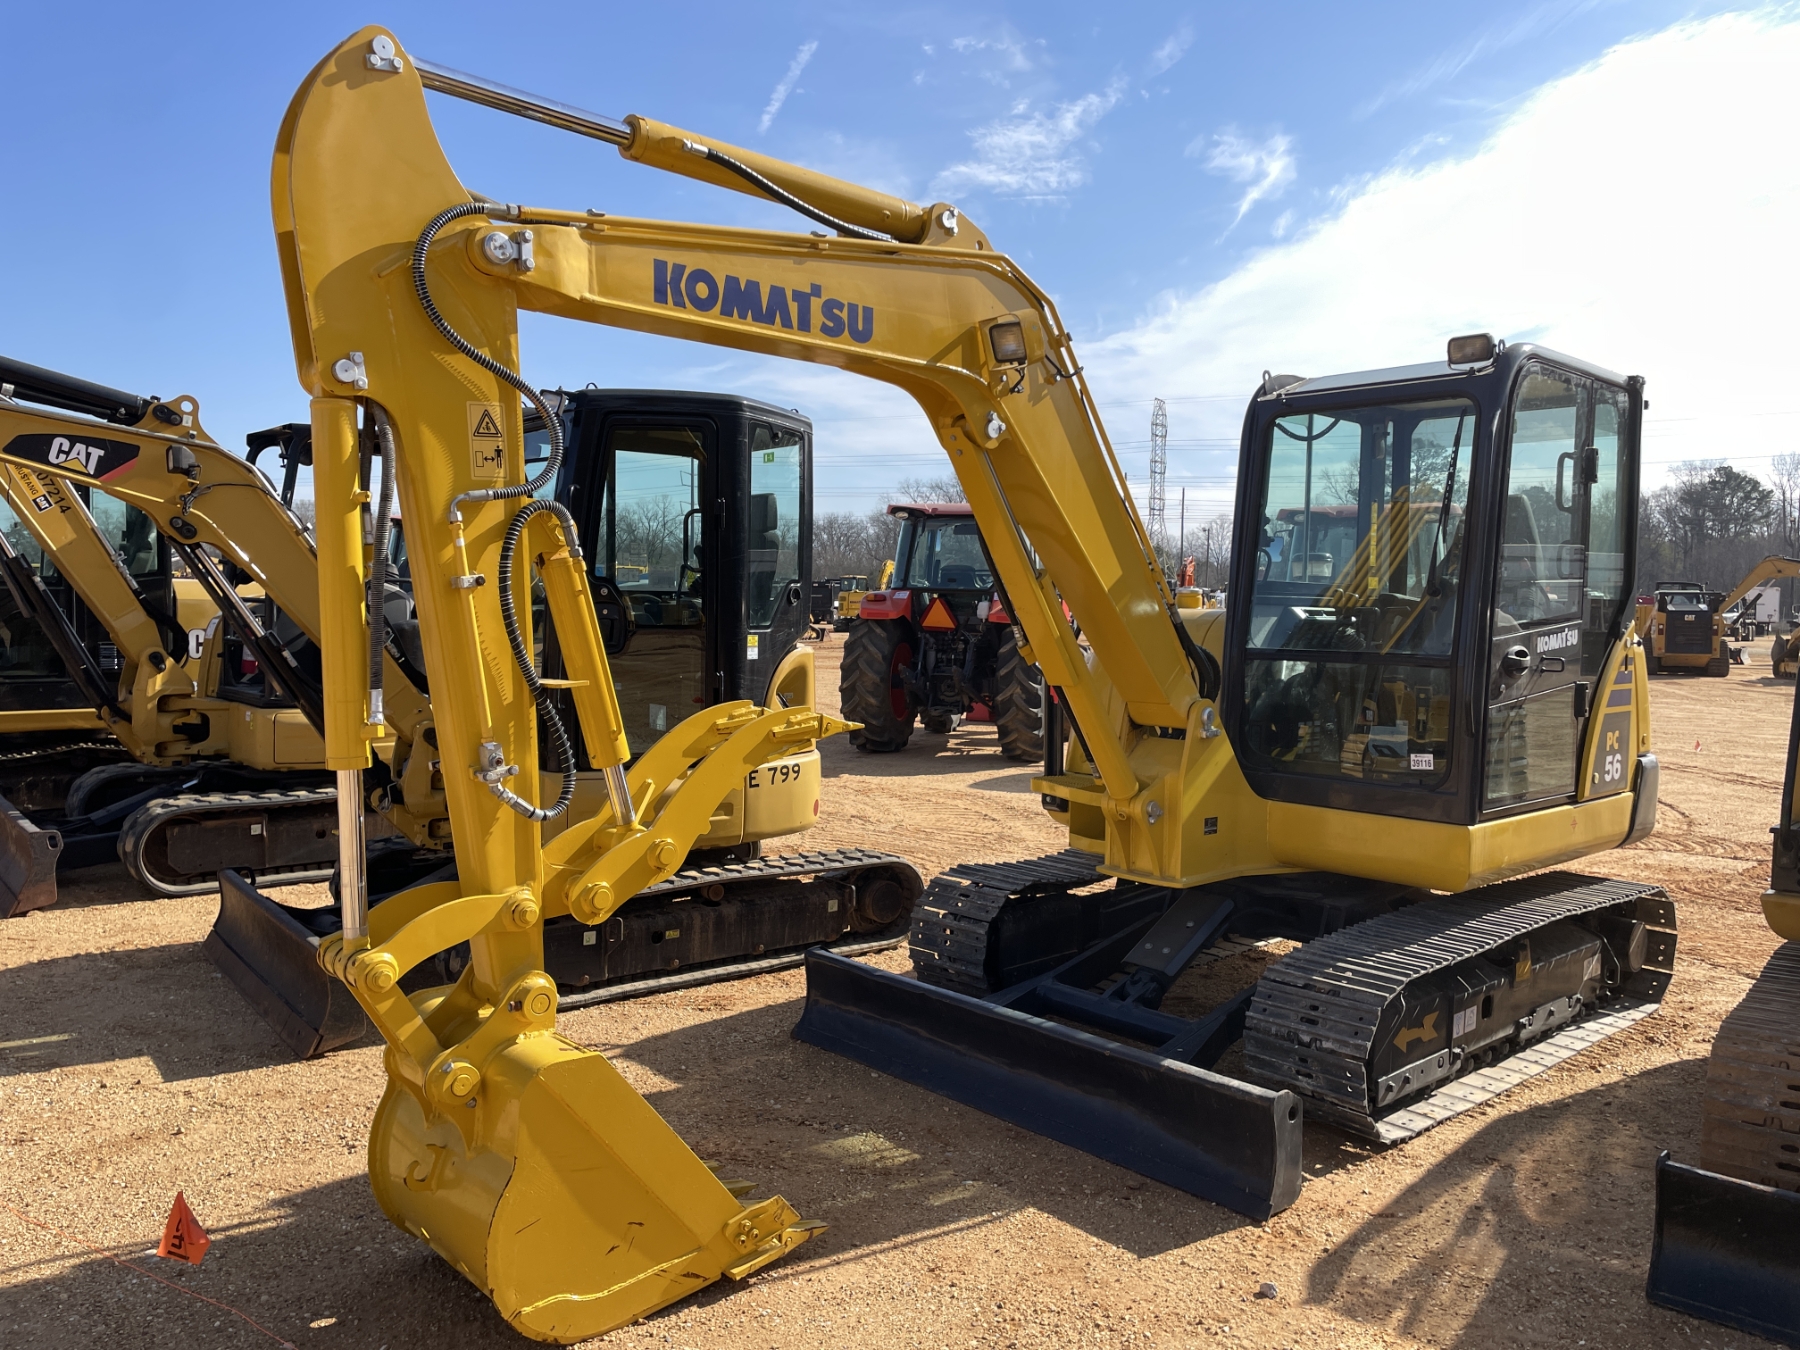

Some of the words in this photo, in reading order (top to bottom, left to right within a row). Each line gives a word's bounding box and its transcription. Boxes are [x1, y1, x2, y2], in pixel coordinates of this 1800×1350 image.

[653, 258, 874, 344] KOMATSU
[48, 437, 105, 475] CAT
[35, 495, 50, 510] CAT
[1537, 627, 1579, 654] KOMATSU
[1606, 730, 1620, 751] PC
[748, 769, 760, 789] E
[767, 763, 801, 786] 799
[1411, 759, 1432, 768] 39116
[1604, 753, 1622, 782] 56
